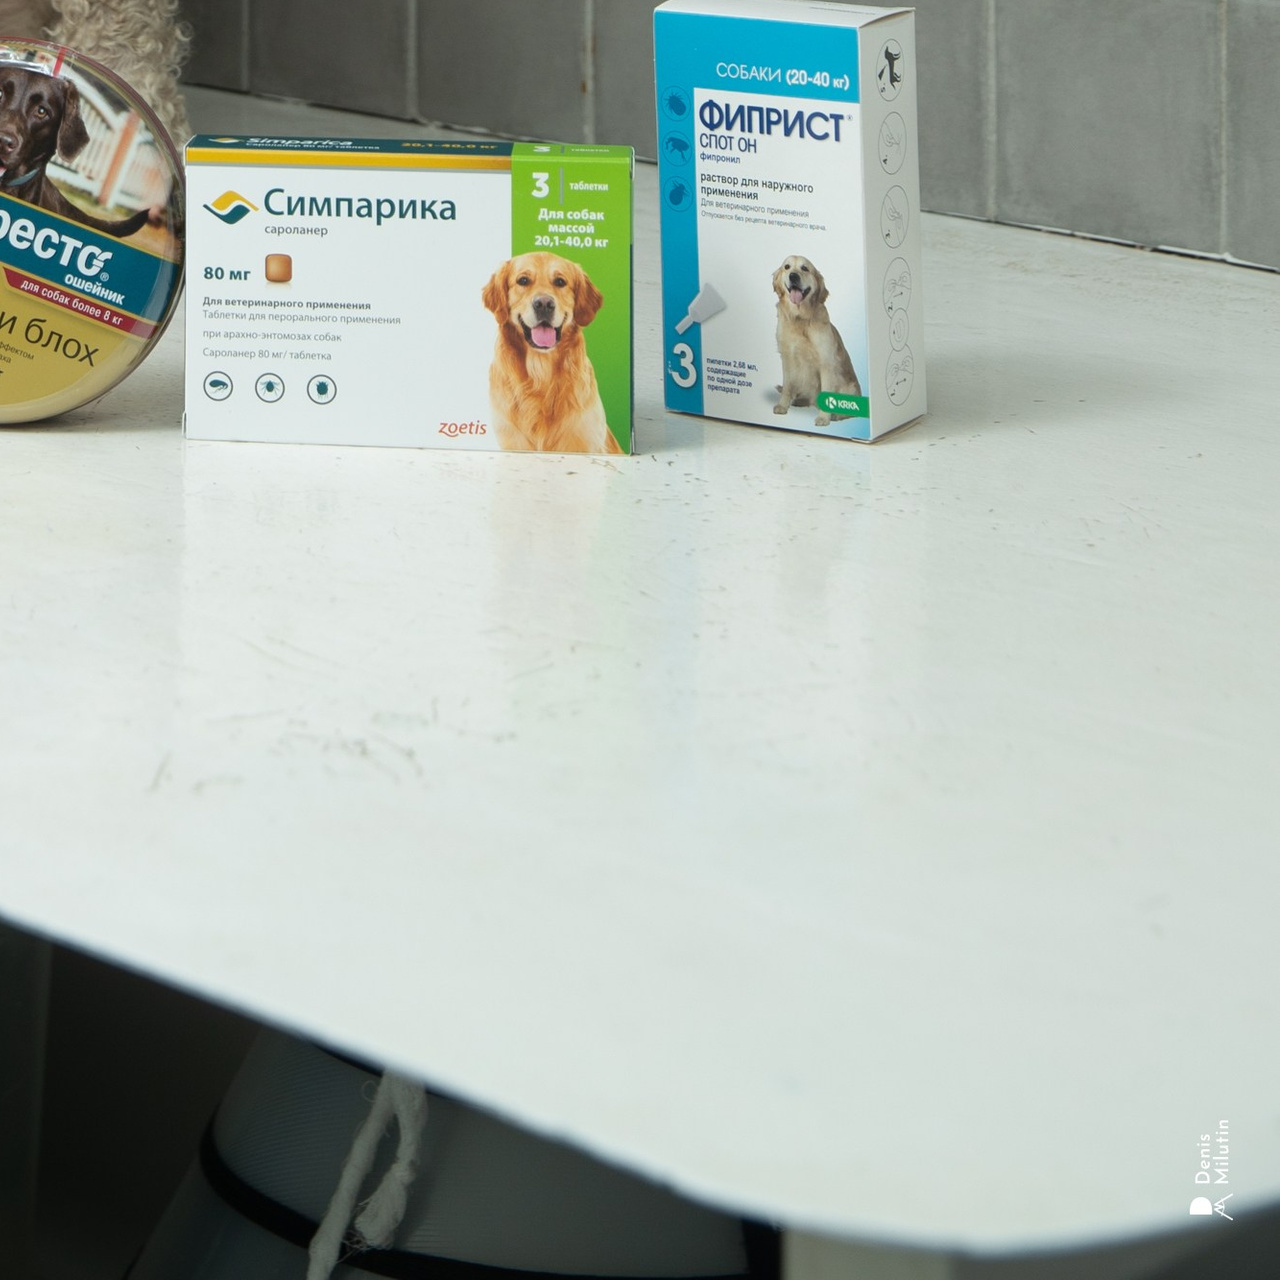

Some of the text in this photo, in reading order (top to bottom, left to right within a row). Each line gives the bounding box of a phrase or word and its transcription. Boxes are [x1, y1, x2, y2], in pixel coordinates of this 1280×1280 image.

[716, 62, 850, 90] СОБАКИ (20-40 кг)
[699, 99, 844, 142] ФИПРИСТ
[247, 137, 354, 146] Simparica
[700, 133, 757, 153] СПОТ ОН
[700, 151, 741, 164] фипронил
[531, 172, 609, 198] 3 таблетки
[701, 173, 814, 193] раствор для наружного
[701, 186, 759, 200] применения
[264, 188, 457, 226] Симпарика
[538, 208, 605, 221] Для собак
[264, 225, 328, 237] сароланер
[548, 222, 595, 234] массой
[534, 235, 609, 248] 20,1-40,0 кг
[203, 266, 251, 281] 80 мг
[64, 273, 125, 305] ошейник
[20, 280, 123, 326] для собак более 8 кг
[203, 297, 371, 310] Для ветеринарного применения
[203, 310, 401, 326] Таблетки для перорального применения
[203, 330, 342, 341] при арахно-энтомозах собак
[24, 318, 99, 367] блох
[203, 348, 332, 361] Сароланер 80 мг/ таблетка
[671, 342, 697, 388] 3
[707, 357, 732, 367] пипетки
[733, 360, 746, 369] 2,68
[707, 367, 746, 378] содержащие
[707, 383, 740, 395] препарата
[717, 377, 735, 385] одной
[737, 380, 752, 388] дозе
[838, 400, 860, 411] KRKA
[438, 420, 487, 438] zoetis
